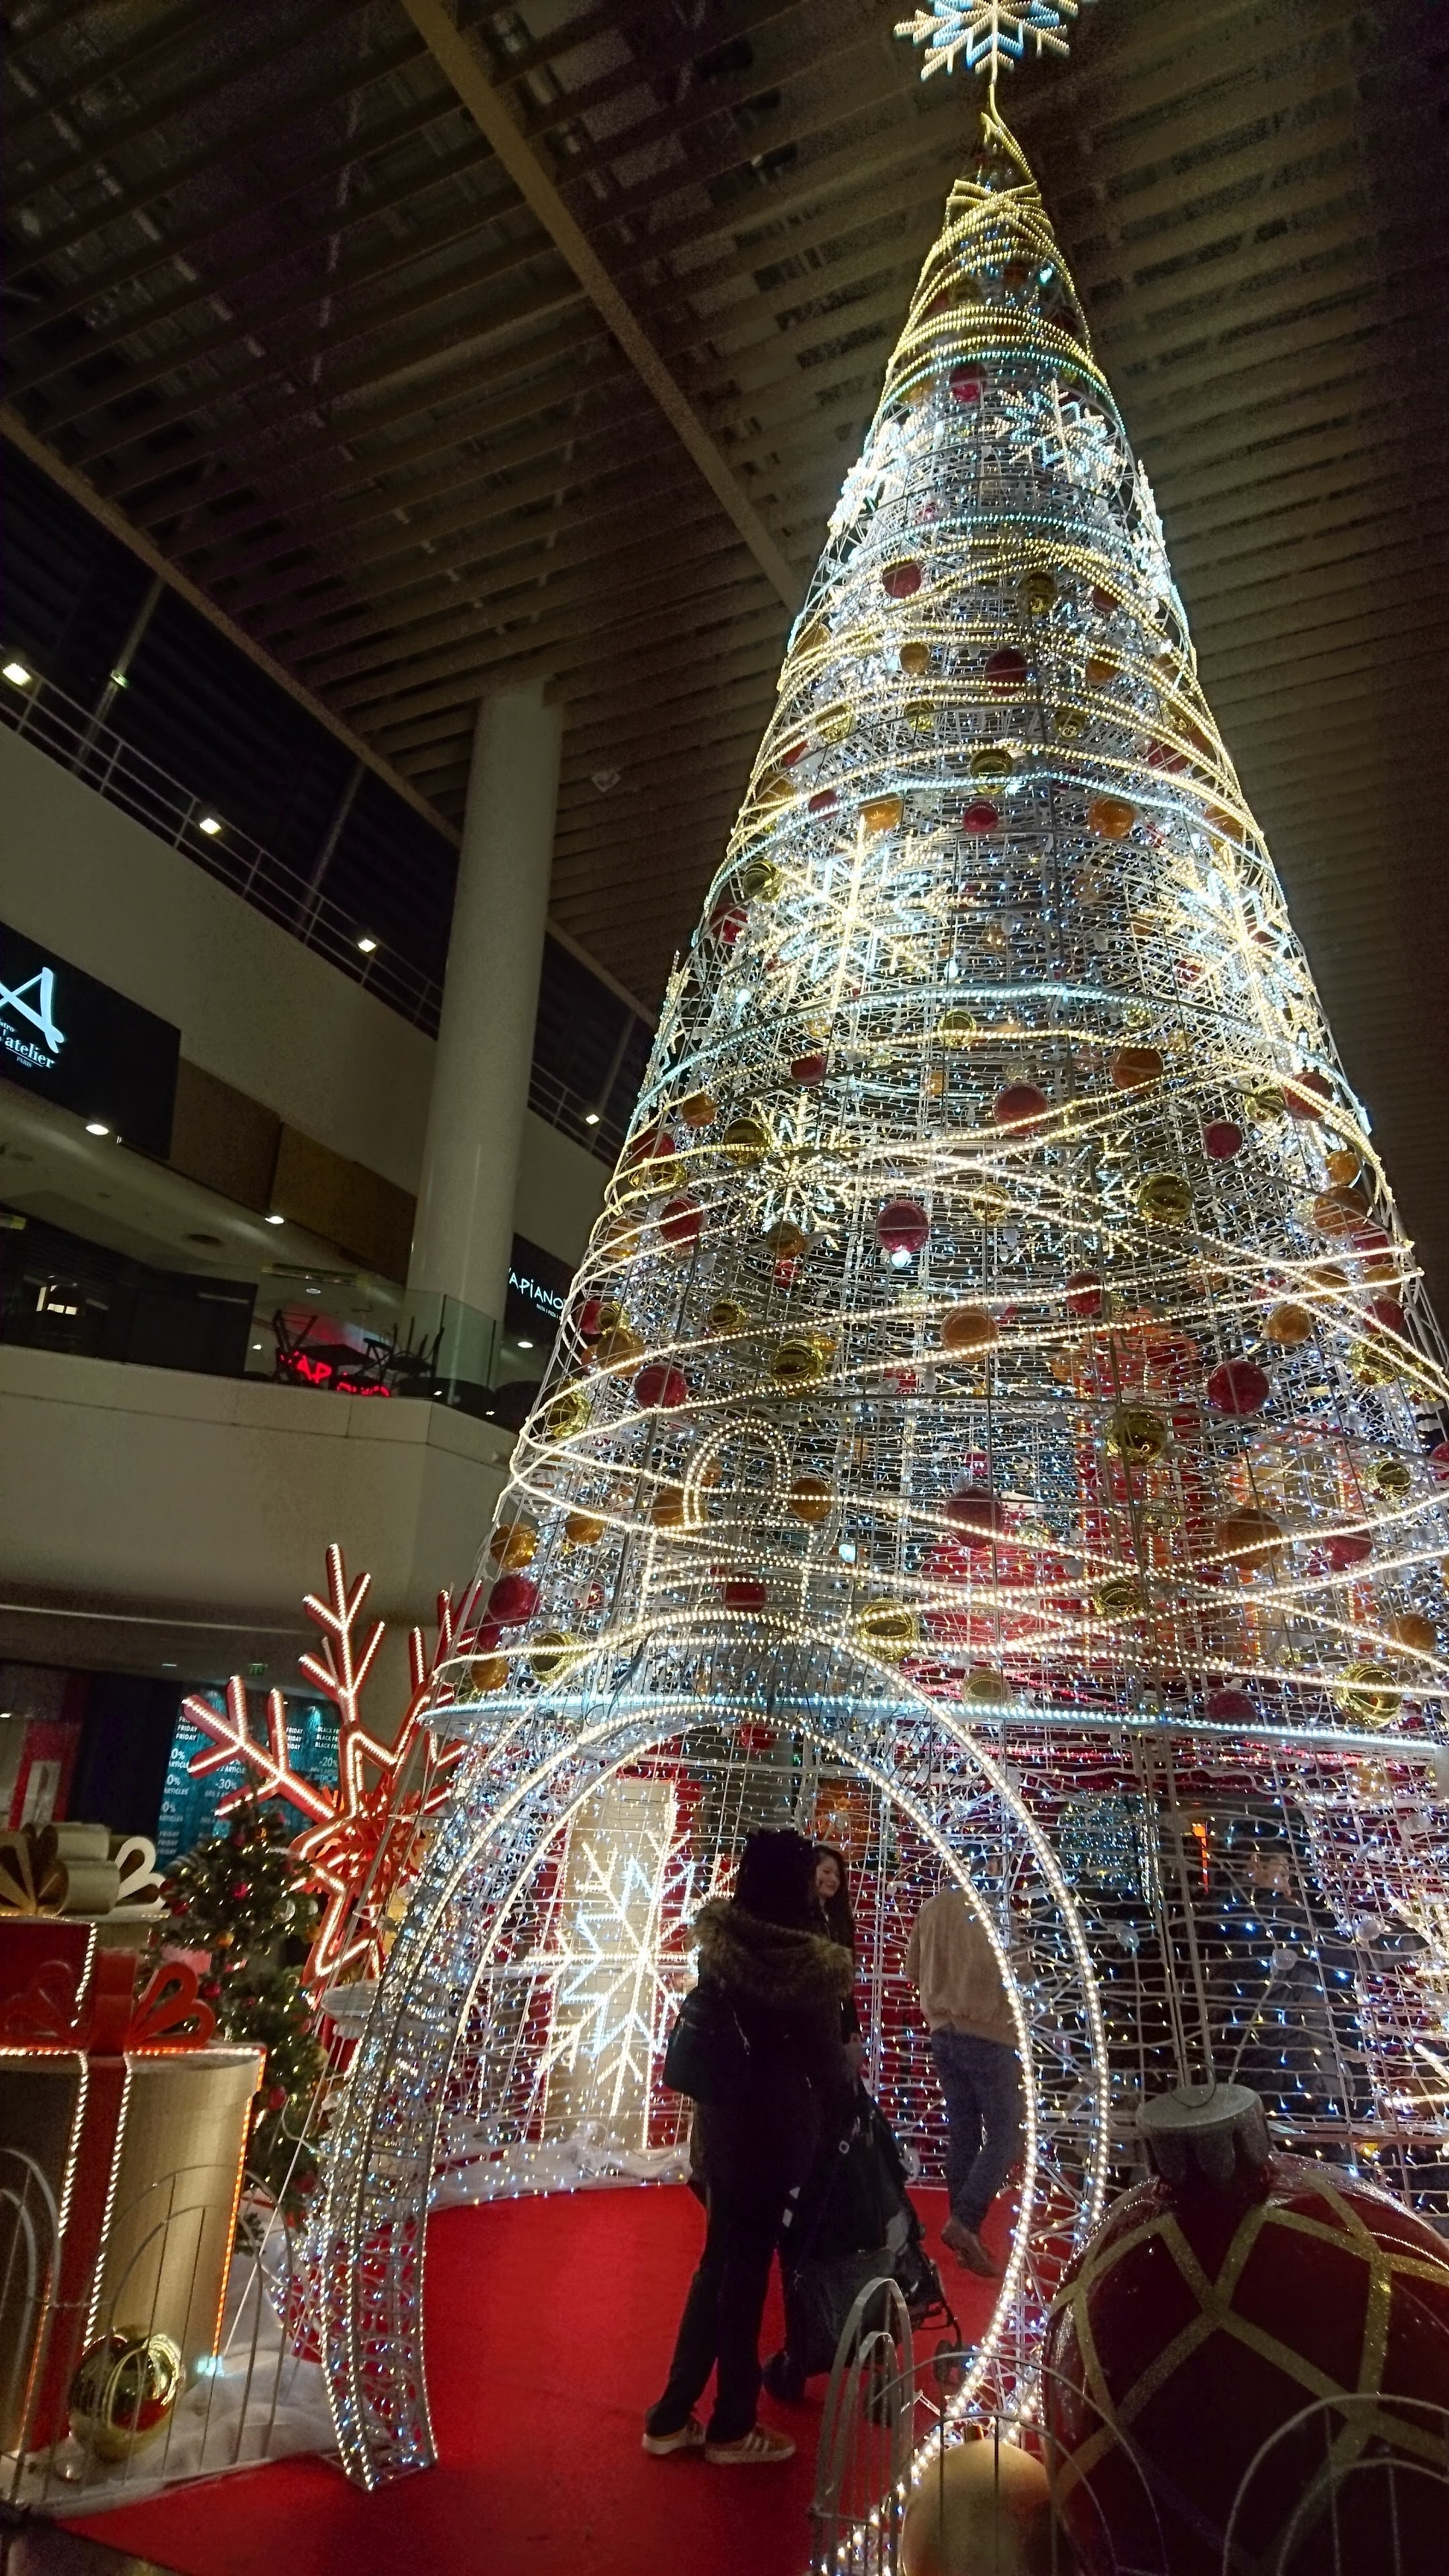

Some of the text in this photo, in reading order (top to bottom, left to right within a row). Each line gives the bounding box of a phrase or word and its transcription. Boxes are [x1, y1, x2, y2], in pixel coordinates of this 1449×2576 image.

[16, 1056, 33, 1068] PARIS
[537, 1303, 545, 1311] PASTA
[548, 1310, 556, 1318] PIZZA
[319, 1757, 337, 1768] -20%
[166, 1774, 180, 1785] 0%
[215, 1778, 237, 1790] -30%
[164, 1787, 189, 1795] ARTICLES
[162, 1801, 176, 1813] 0%
